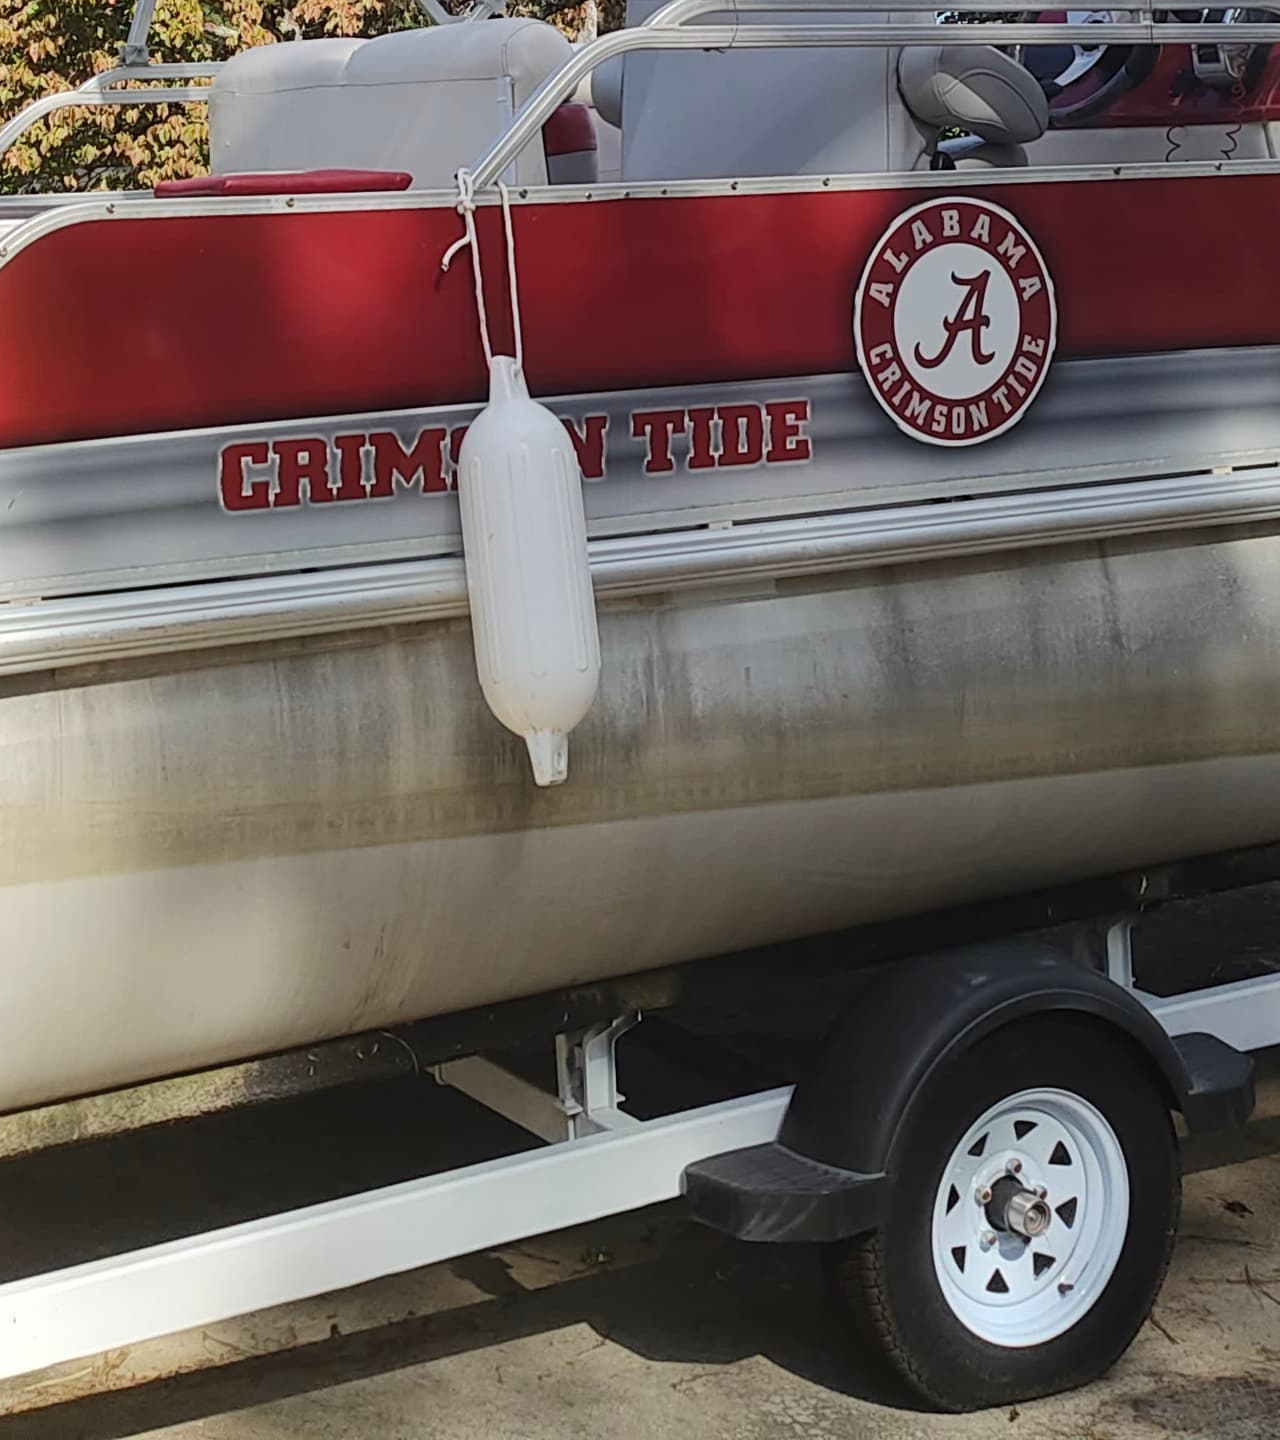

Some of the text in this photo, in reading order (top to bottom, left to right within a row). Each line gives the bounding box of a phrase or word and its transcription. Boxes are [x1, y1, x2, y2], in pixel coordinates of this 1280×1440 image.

[869, 209, 1042, 307] ALABAMA
[870, 333, 1045, 435] CRIMSON TIDE
[219, 399, 811, 511] CRIMN TIDE
